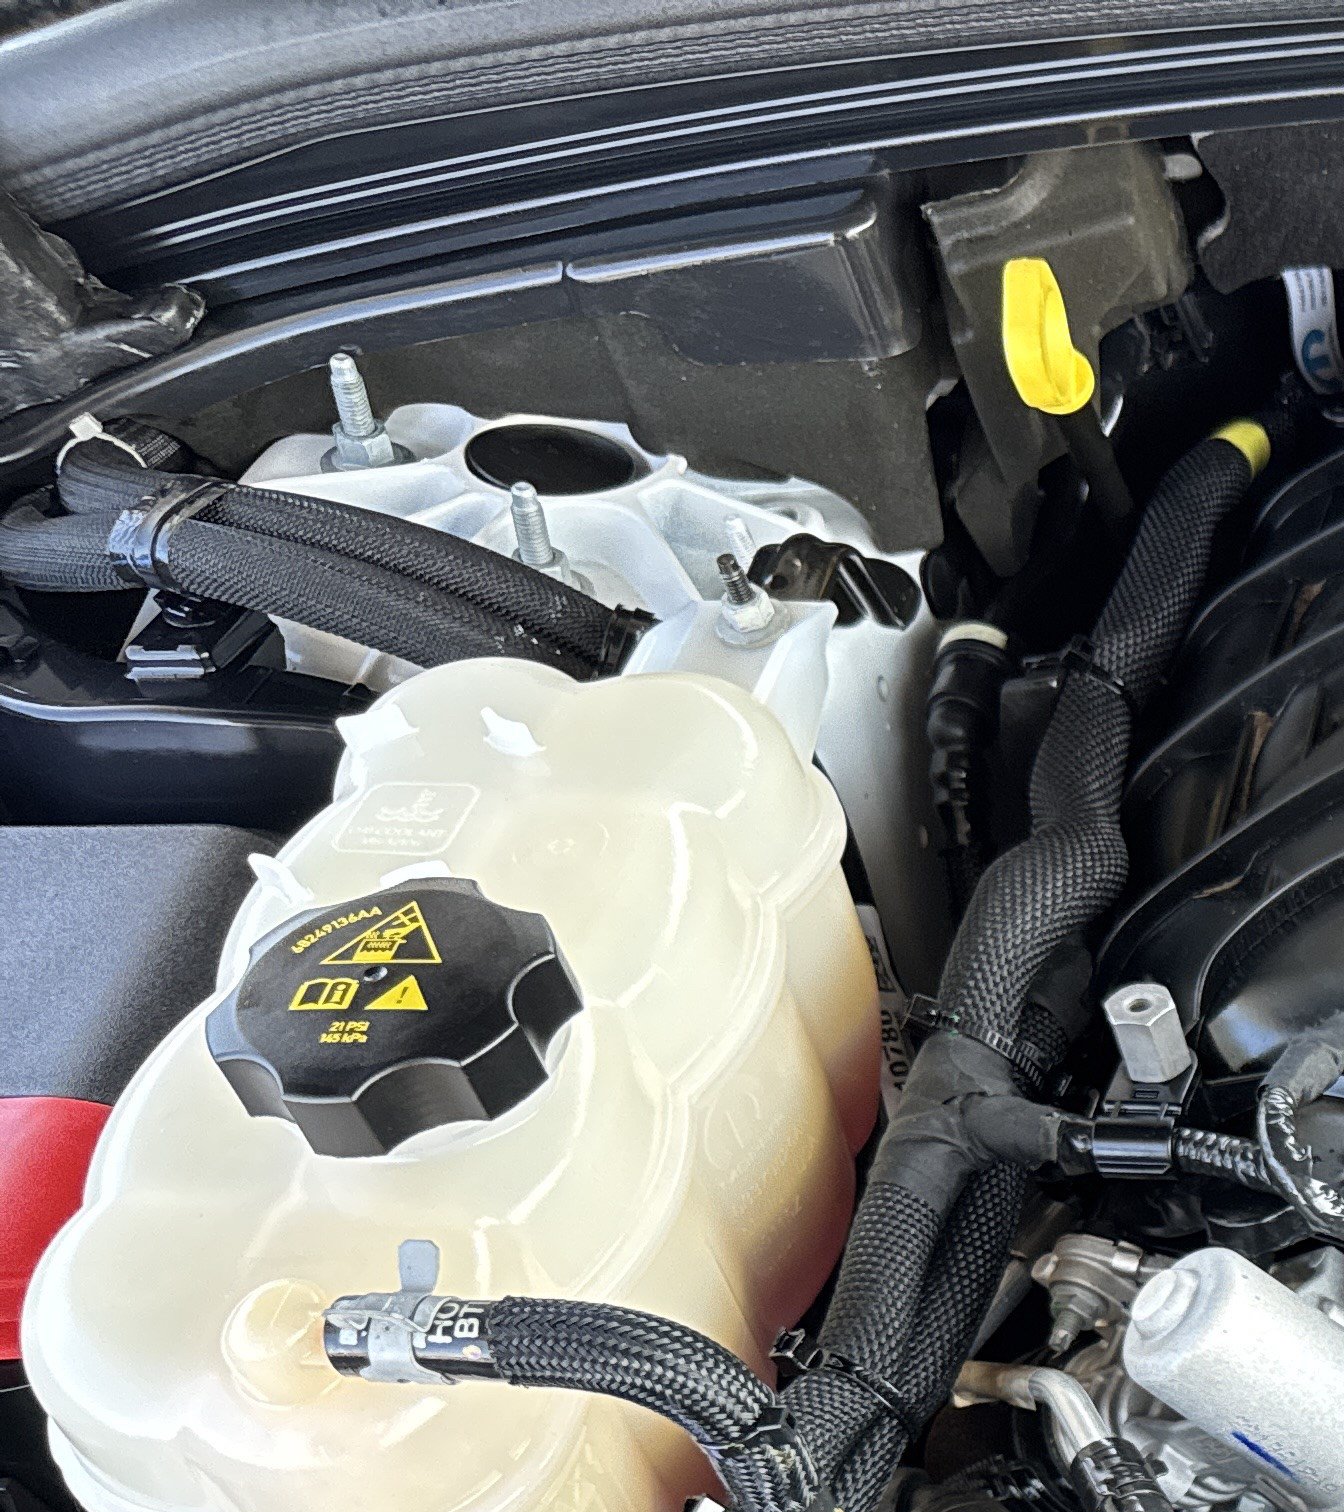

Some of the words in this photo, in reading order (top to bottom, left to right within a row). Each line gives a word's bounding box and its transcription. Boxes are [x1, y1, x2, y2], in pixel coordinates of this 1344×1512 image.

[291, 906, 383, 954] 68249136AA
[330, 1021, 345, 1032] 21
[346, 1021, 370, 1032] PSI
[342, 1034, 368, 1043] kPa
